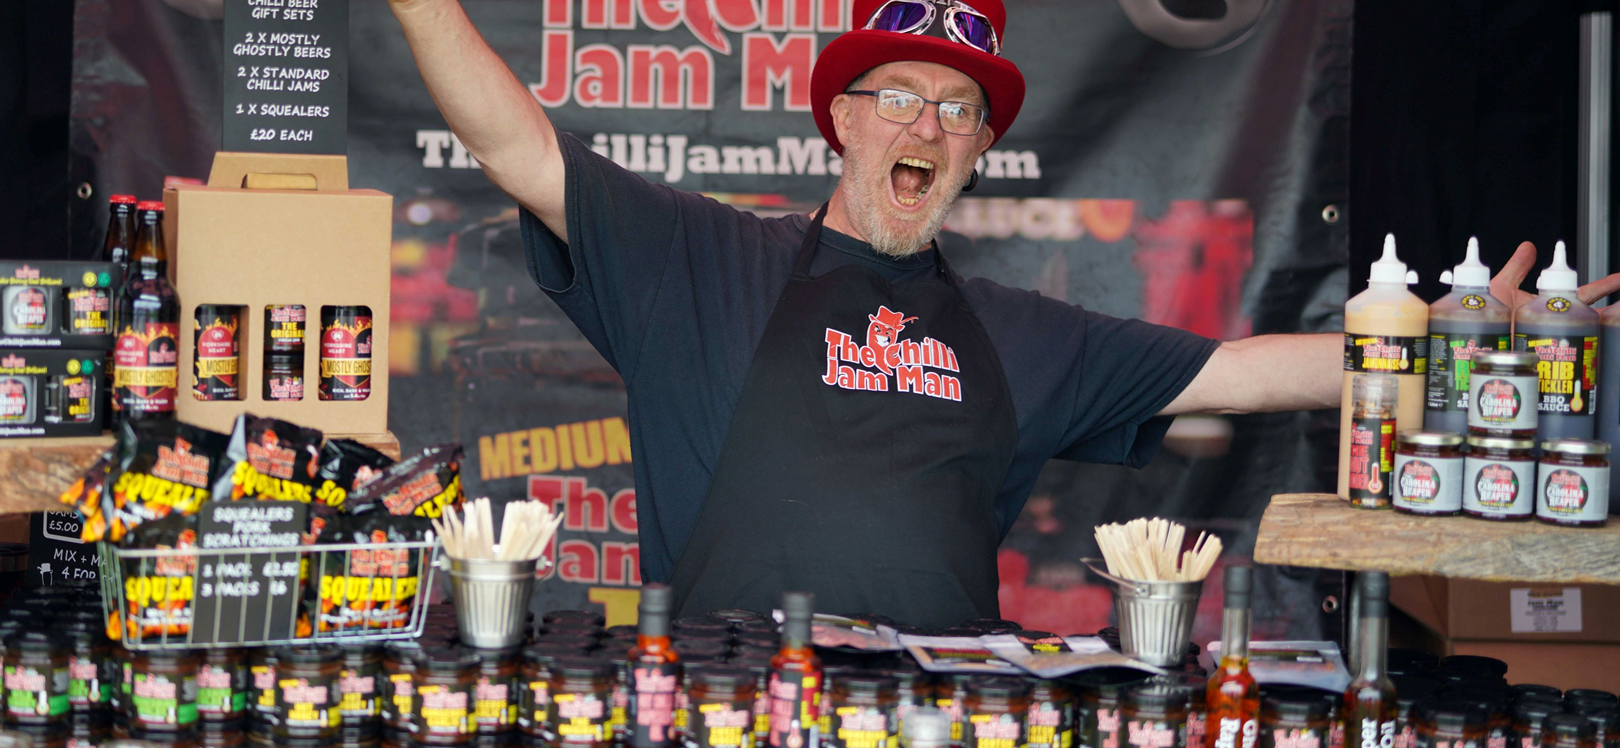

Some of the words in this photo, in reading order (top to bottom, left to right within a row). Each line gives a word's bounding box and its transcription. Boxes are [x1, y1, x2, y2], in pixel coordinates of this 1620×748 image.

[288, 0, 318, 8] BEER
[252, 8, 279, 19] GIFT
[283, 9, 314, 21] SETS
[245, 32, 254, 43] 2
[257, 33, 267, 43] X
[270, 33, 320, 45] MOSTLY
[233, 43, 291, 56] GHOSTLY
[294, 47, 331, 58] BEERS
[237, 66, 246, 77] 2
[250, 66, 259, 77] X
[263, 67, 330, 80] STANDARD
[528, 28, 714, 110] Jam
[246, 79, 284, 90] CHILLI
[287, 80, 320, 92] JAMS
[236, 104, 244, 114] 1
[248, 104, 257, 114] X
[260, 104, 330, 117] SQUEALERS
[250, 128, 276, 141] £20
[280, 129, 313, 141] EACH
[86, 311, 101, 320] THE
[281, 322, 297, 331] THE
[271, 330, 305, 338] ORIGINAL
[825, 327, 875, 367] The
[885, 336, 960, 373] Chilli
[206, 359, 229, 373] MOSTLY
[327, 360, 352, 373] MOSTLY
[353, 360, 371, 373] GHOS
[1537, 360, 1575, 380] RIB
[119, 369, 143, 383] MOSTLY
[145, 369, 174, 383] GHOSTLY
[822, 358, 888, 391] Jam
[896, 365, 962, 401] Man
[1537, 380, 1573, 394] TICKLER
[1480, 397, 1517, 408] CAROLINA
[1537, 402, 1570, 412] SAUCE
[1543, 395, 1565, 406] BBQ
[1482, 405, 1513, 417] REAPER
[1400, 478, 1435, 489] CAROLINA
[1477, 481, 1515, 492] CAROLINA
[1402, 486, 1431, 498] REAPER
[1480, 490, 1511, 502] REAPER
[1546, 486, 1584, 498] CAROLINA
[527, 474, 638, 535] The
[1549, 496, 1579, 507] REAPER
[213, 506, 294, 522] SQUEALERS
[49, 520, 79, 533] £5.00
[232, 521, 271, 534] PORK
[203, 532, 299, 549] SCRATCHINGS
[53, 548, 77, 562] MIX
[81, 555, 87, 564] +
[61, 566, 70, 579] 4
[202, 563, 213, 578] 1
[215, 562, 253, 578] PACK
[201, 582, 213, 597] 3
[215, 581, 260, 597] PACKS
[270, 580, 287, 595] £6
[319, 575, 422, 606] SQUEALER
